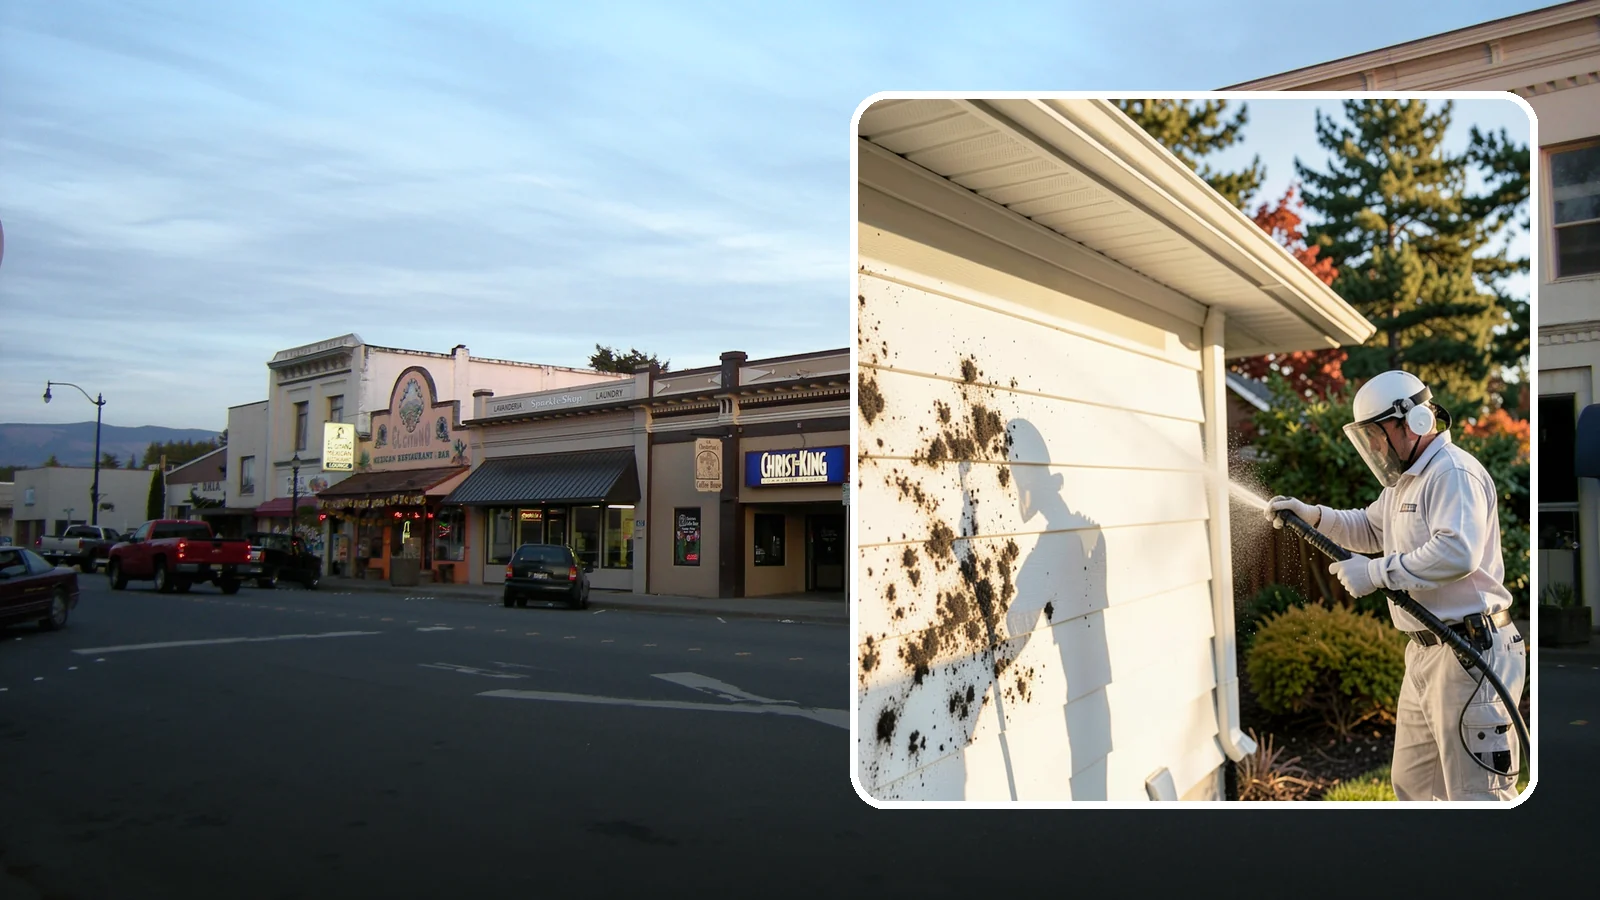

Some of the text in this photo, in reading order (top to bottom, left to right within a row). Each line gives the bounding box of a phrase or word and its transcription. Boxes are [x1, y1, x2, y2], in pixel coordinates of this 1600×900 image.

[595, 389, 624, 401] LAUNDRY
[493, 402, 523, 413] LAVANDERIA
[530, 394, 583, 410] Sparkle Shop
[373, 455, 396, 464] MEXICAN
[397, 451, 433, 462] RESTAURANT
[438, 450, 450, 459] BAR
[761, 450, 827, 478] CHRIST KING
[697, 481, 722, 489] Coffee House
